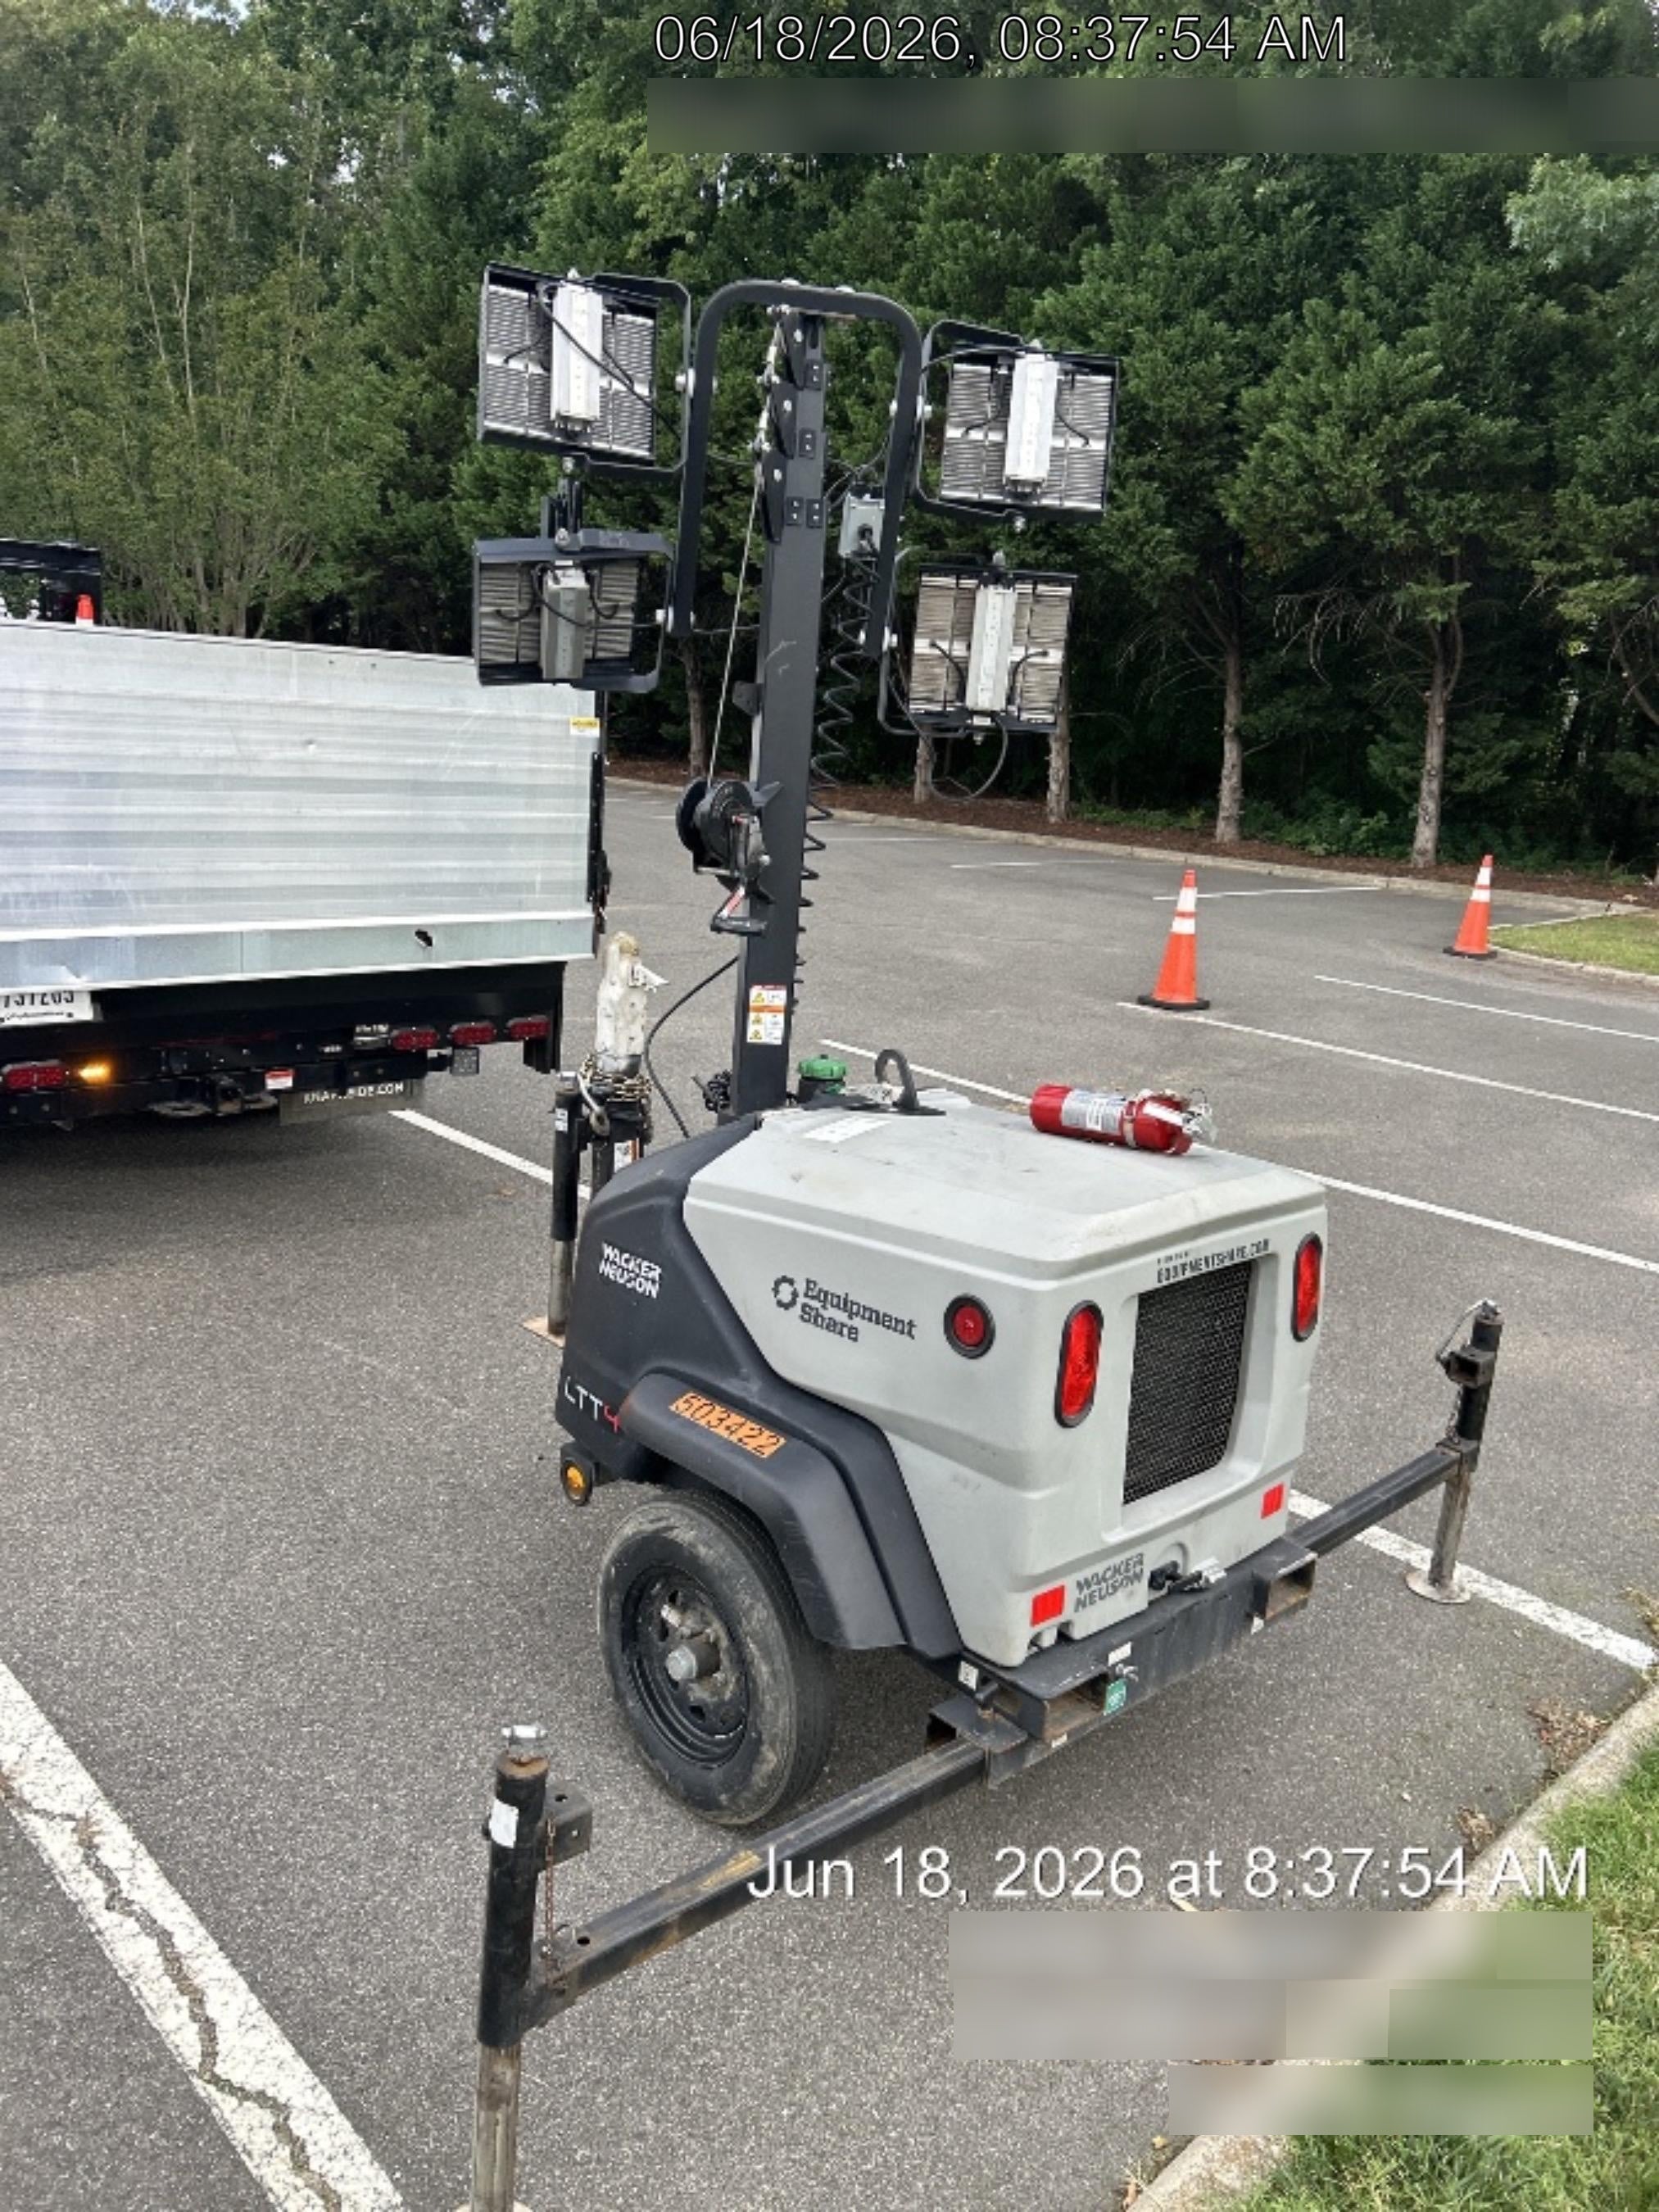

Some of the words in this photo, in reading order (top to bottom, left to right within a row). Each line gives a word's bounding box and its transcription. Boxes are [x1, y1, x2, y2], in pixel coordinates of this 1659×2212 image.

[599, 1258, 660, 1299] NEUSON
[601, 1240, 662, 1281] WACKER
[799, 1302, 859, 1343] Share
[803, 1277, 917, 1340] Equipment
[564, 1376, 621, 1434] LTT4
[674, 1394, 781, 1456] 503422
[1073, 1566, 1145, 1613] NEUSON
[1076, 1552, 1145, 1596] WACKER
